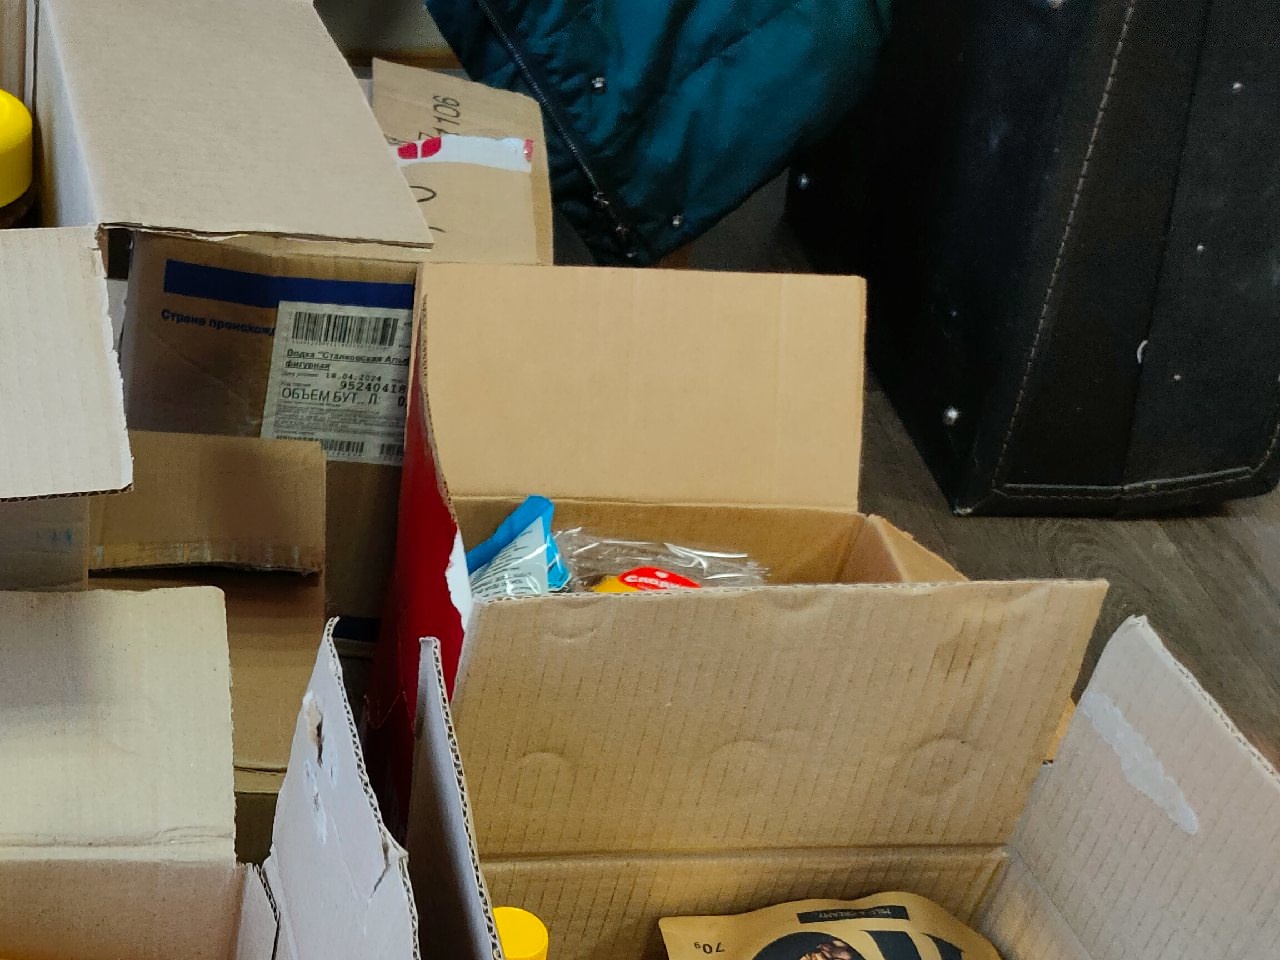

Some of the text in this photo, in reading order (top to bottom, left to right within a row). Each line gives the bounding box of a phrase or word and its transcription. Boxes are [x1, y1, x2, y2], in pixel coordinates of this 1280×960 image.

[161, 309, 207, 327] Страна
[281, 387, 330, 402] ОБЪЕМ
[693, 941, 726, 954] 70g
